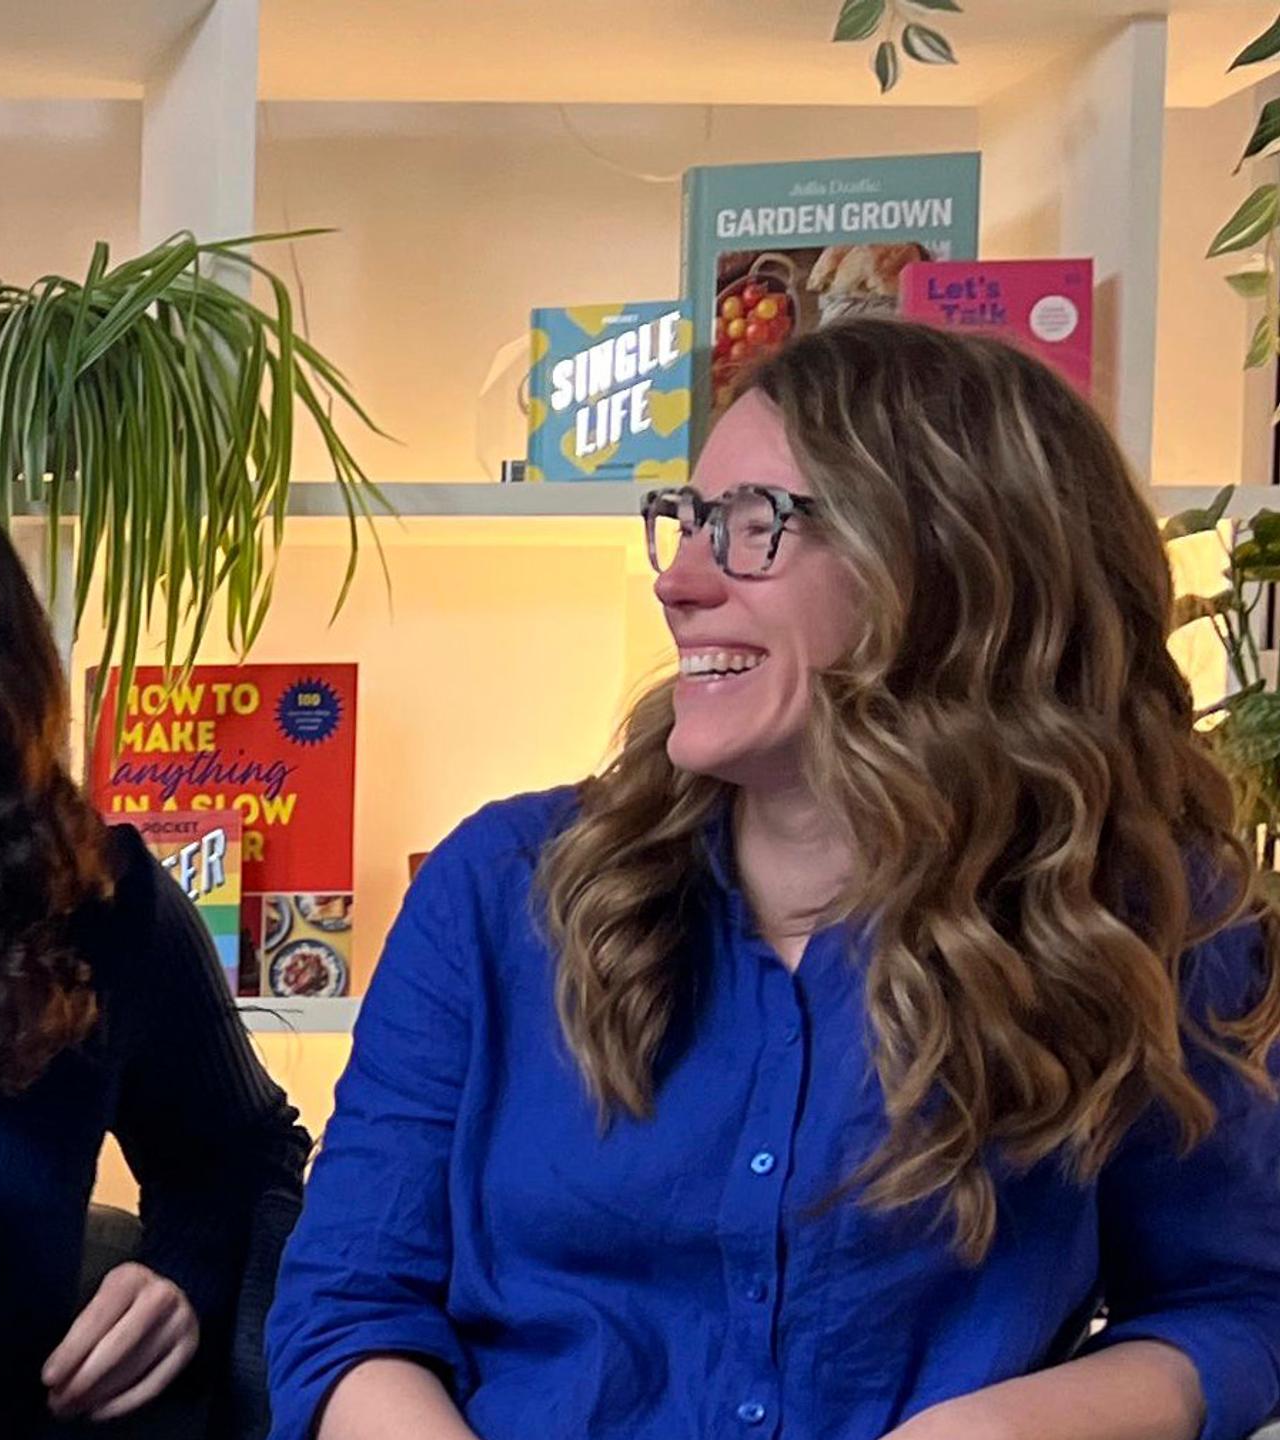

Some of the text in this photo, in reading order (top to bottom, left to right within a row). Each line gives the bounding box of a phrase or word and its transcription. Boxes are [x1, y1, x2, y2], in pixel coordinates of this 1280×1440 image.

[715, 197, 953, 239] GARDEN GROWN
[551, 310, 682, 412] SINGLE
[575, 379, 654, 458] LIFE
[211, 683, 261, 716] TO
[120, 720, 217, 753] MAKE
[112, 748, 299, 802] anything
